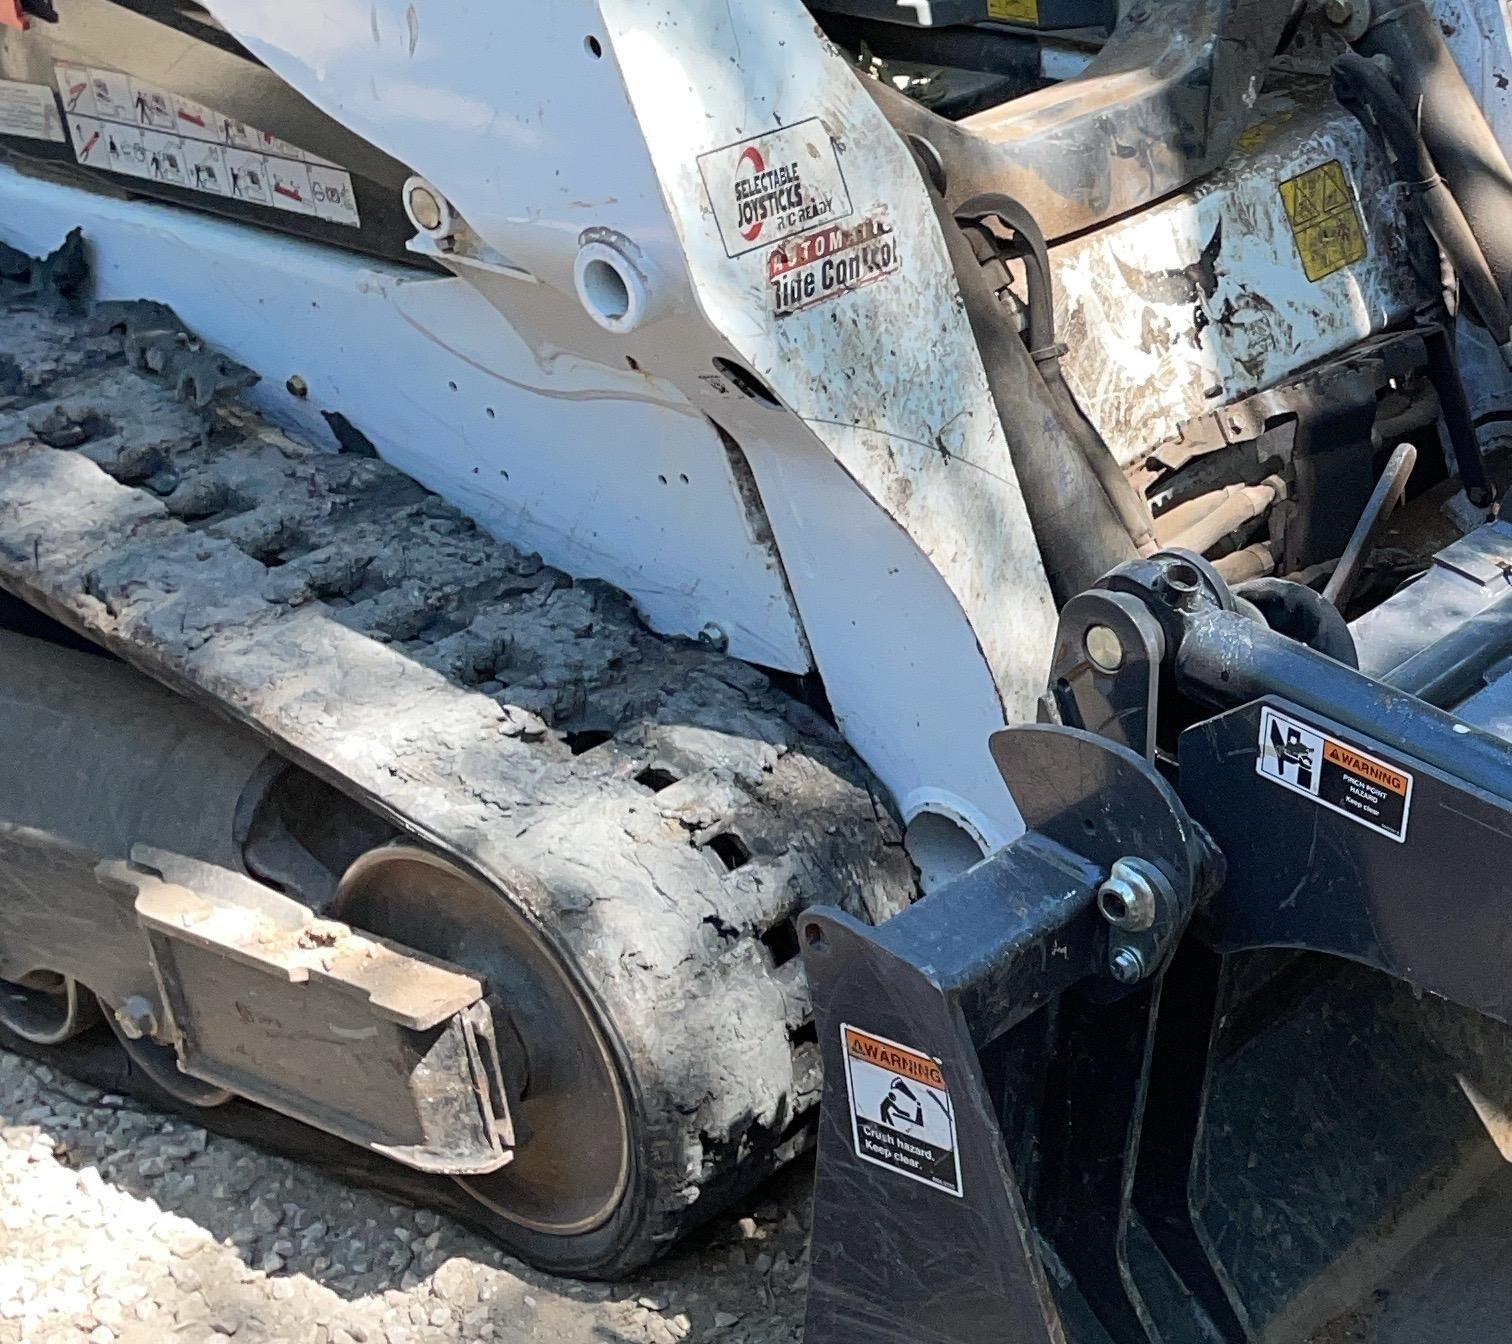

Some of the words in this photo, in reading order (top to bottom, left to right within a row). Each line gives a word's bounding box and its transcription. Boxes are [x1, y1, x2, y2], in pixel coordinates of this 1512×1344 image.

[734, 162, 800, 202] SELECTABLE
[737, 182, 803, 228] JOYSTICKS
[798, 197, 833, 223] READY
[1341, 752, 1401, 789] WARNING
[1342, 773, 1366, 789] PINCH
[1365, 784, 1388, 800] POINT
[1345, 795, 1363, 809] Keep
[1349, 785, 1379, 804] HAZARD
[863, 1042, 942, 1084] WARNING
[863, 1125, 895, 1146] Crush
[896, 1137, 936, 1163] hazard.
[864, 1138, 892, 1159] Keep
[893, 1151, 923, 1171] clear.
